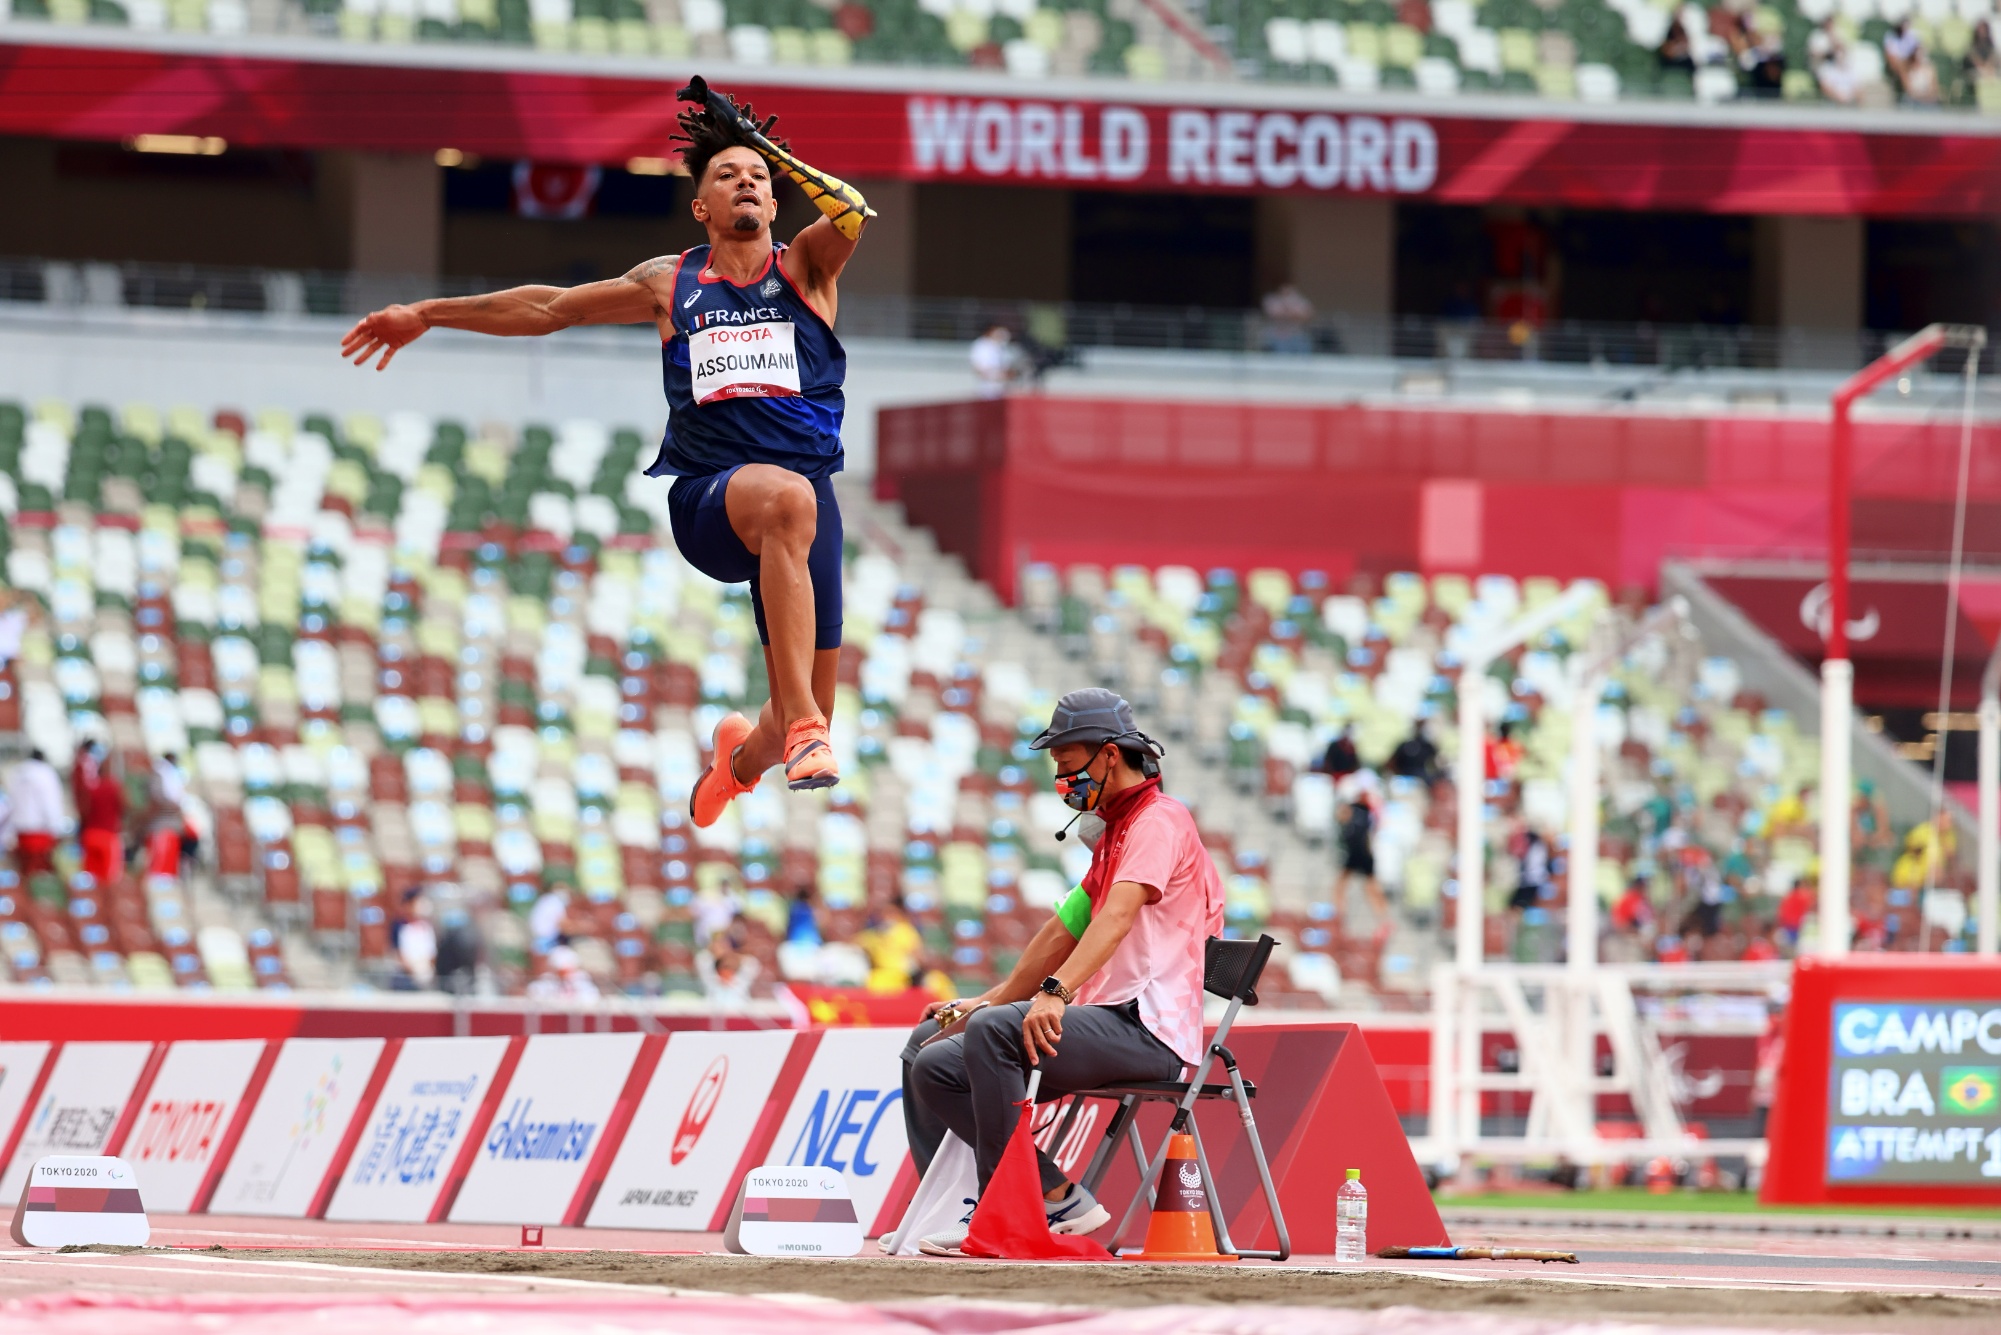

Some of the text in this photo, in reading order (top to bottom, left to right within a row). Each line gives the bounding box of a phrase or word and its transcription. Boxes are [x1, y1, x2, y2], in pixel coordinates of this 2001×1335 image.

[907, 99, 1438, 192] WORLD RECORD
[704, 307, 782, 325] FRANCE
[708, 328, 773, 344] TOYOTA
[697, 353, 795, 380] ASSOUMANI
[1840, 1068, 1935, 1117] BRA
[130, 1100, 226, 1162] TOYOTA
[788, 1089, 903, 1177] NEC
[1833, 1126, 1984, 1162] ATTEMPT
[41, 1167, 98, 1177] TOKYO 2020
[753, 1178, 809, 1188] TOKYO 2020
[619, 1188, 699, 1208] JAPAN AIRLINES
[785, 1244, 822, 1252] MONDO
